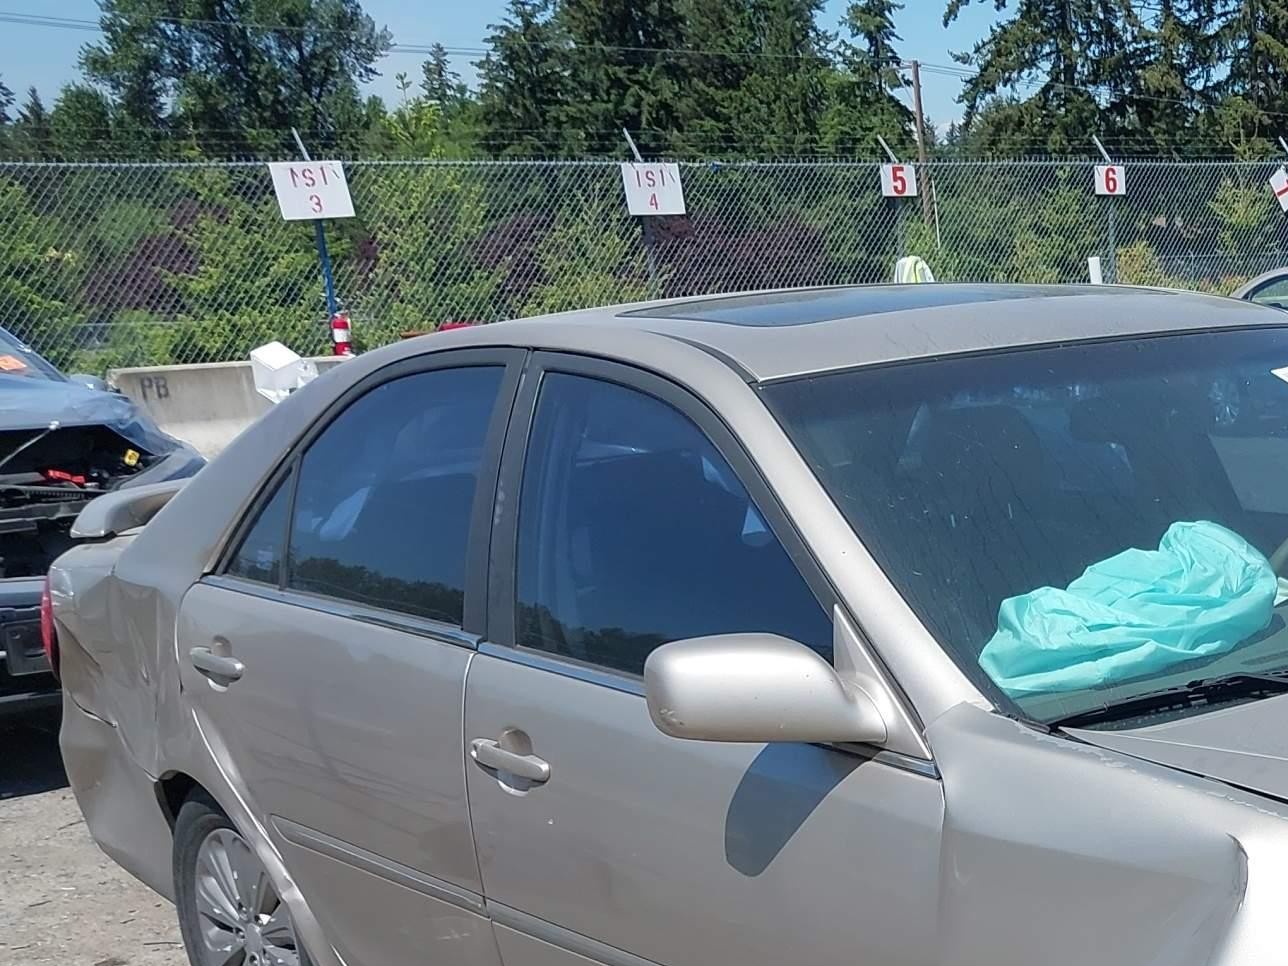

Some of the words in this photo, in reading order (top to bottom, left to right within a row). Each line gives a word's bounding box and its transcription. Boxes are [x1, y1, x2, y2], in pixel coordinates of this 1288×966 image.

[892, 166, 906, 195] 5
[1105, 167, 1117, 193] 6
[310, 195, 323, 213] 3
[650, 193, 658, 210] 4
[140, 376, 169, 401] PB
